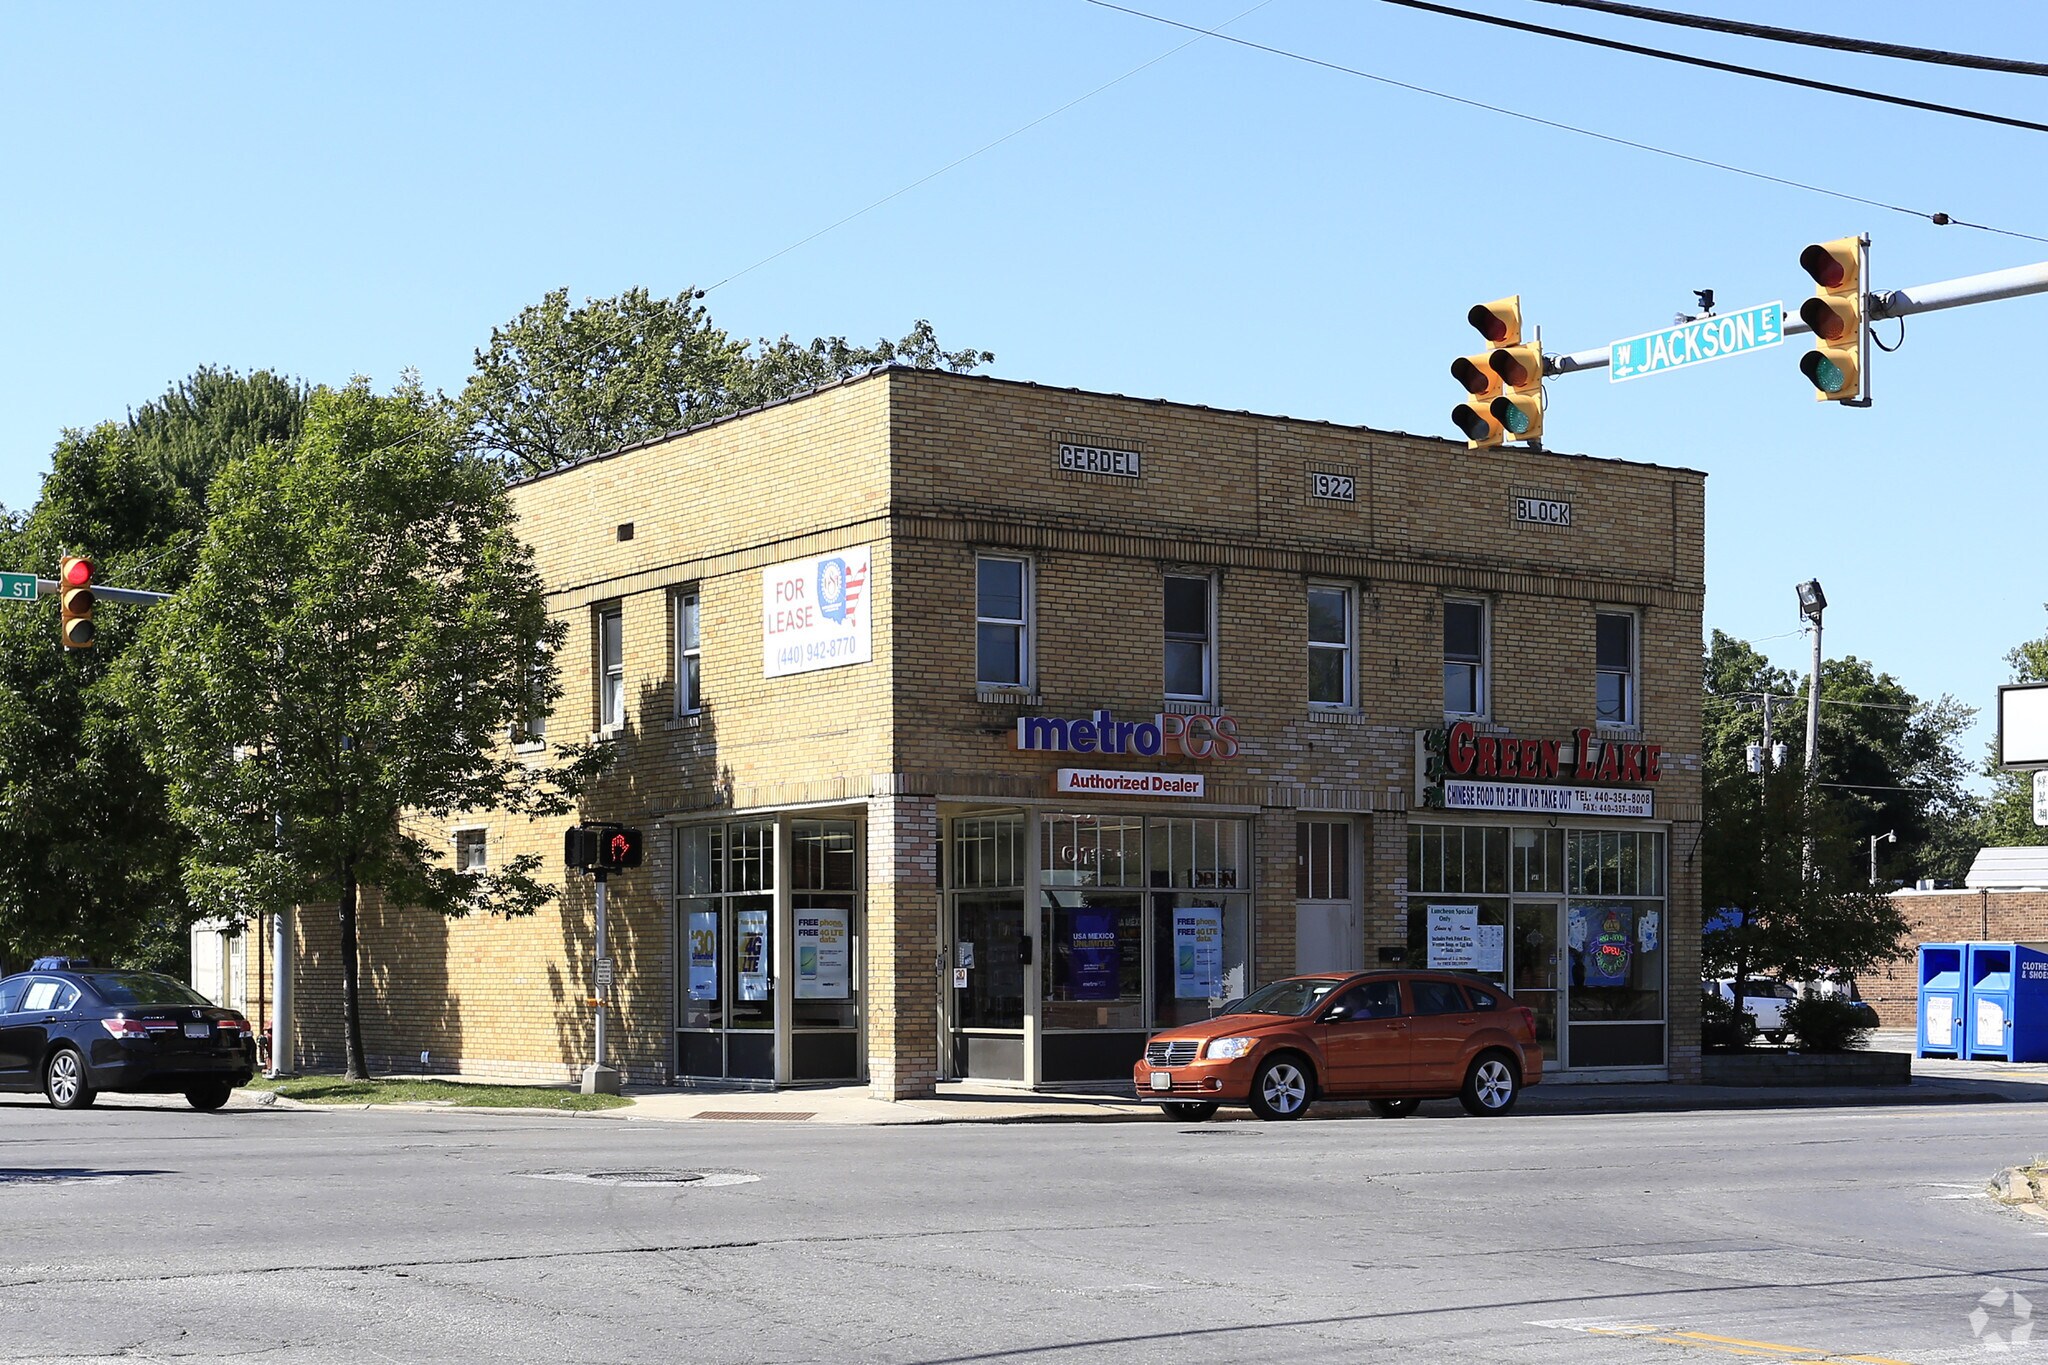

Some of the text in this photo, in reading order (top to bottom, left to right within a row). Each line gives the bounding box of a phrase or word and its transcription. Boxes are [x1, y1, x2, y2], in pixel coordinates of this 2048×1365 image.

[1617, 308, 1773, 373] W JACKSON E
[1061, 446, 1138, 475] GERDEL
[1314, 475, 1352, 499] 1922
[1518, 500, 1568, 523] BLOCK
[13, 582, 31, 597] ST
[776, 578, 804, 604] FOR
[769, 606, 813, 634] LEASE
[778, 645, 803, 670] (440)
[1018, 710, 1240, 760] metroPCS
[1449, 721, 1662, 782] GREEN LAKE
[1070, 773, 1199, 793] Authorized Dealer
[1447, 784, 1572, 809] CHINESE FOOD TO EAT IN OR TAKE OUT
[1575, 790, 1591, 802] TEL:
[1583, 803, 1597, 812] FAX:
[1438, 915, 1451, 923] Only
[1087, 932, 1115, 940] MEXICO
[1177, 928, 1195, 936] FREE
[744, 936, 762, 955] 4G
[1603, 945, 1620, 956] OPEN
[743, 956, 760, 972] LTE
[2022, 961, 2048, 970] CLOTHE
[2029, 971, 2048, 979] SHOE
